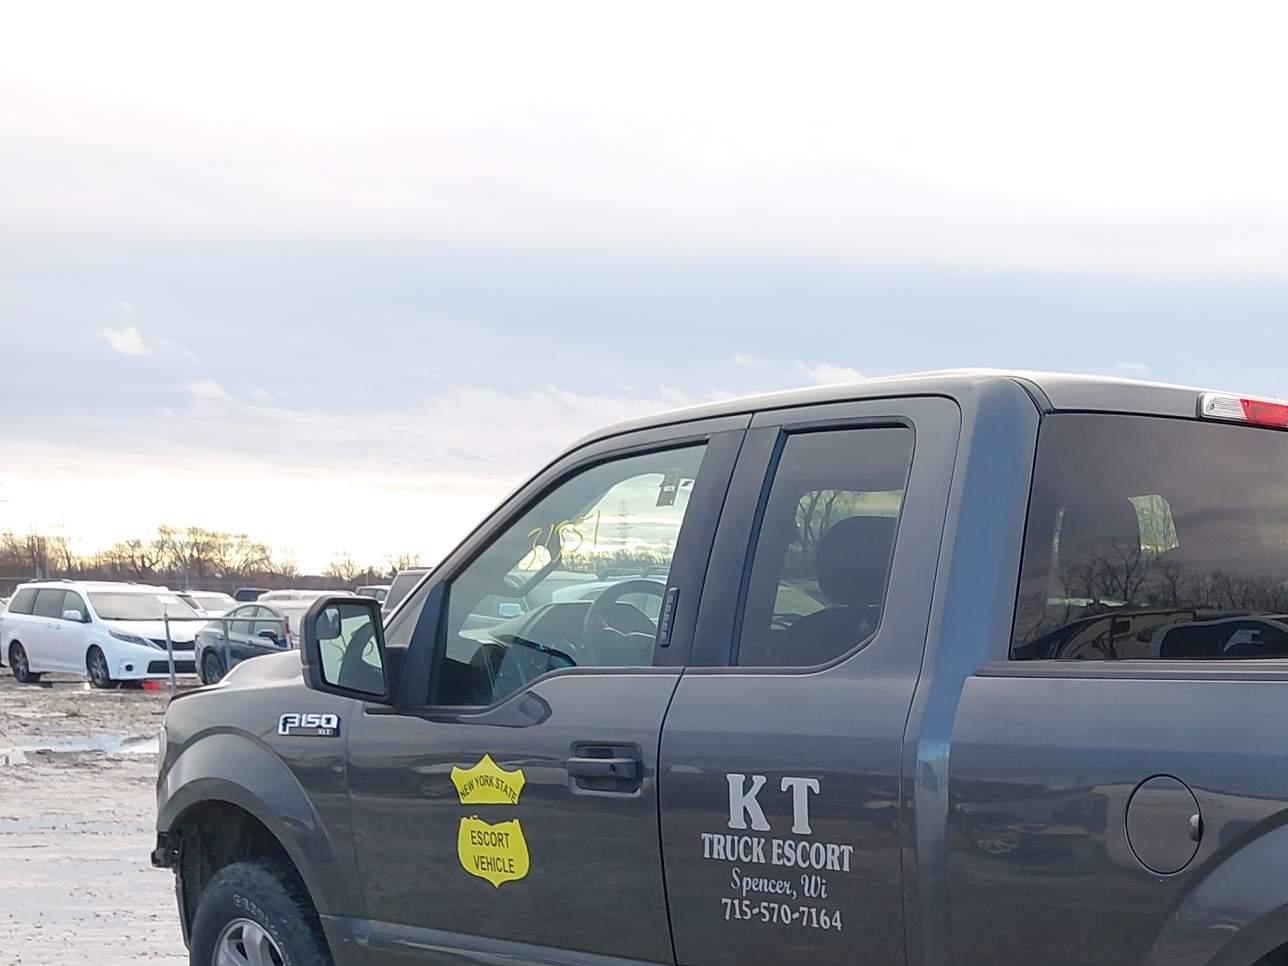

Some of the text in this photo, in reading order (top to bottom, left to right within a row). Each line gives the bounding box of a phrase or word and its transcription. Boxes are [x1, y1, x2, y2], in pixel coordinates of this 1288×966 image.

[459, 774, 518, 804] NEW YORK STATE
[726, 773, 821, 835] K T
[470, 830, 511, 849] ESCORT
[700, 832, 855, 872] TRUCK ESCORT
[472, 855, 516, 874] VEHICLE
[730, 866, 829, 900] Spencer, Wi
[720, 898, 843, 932] 715-570-7164
